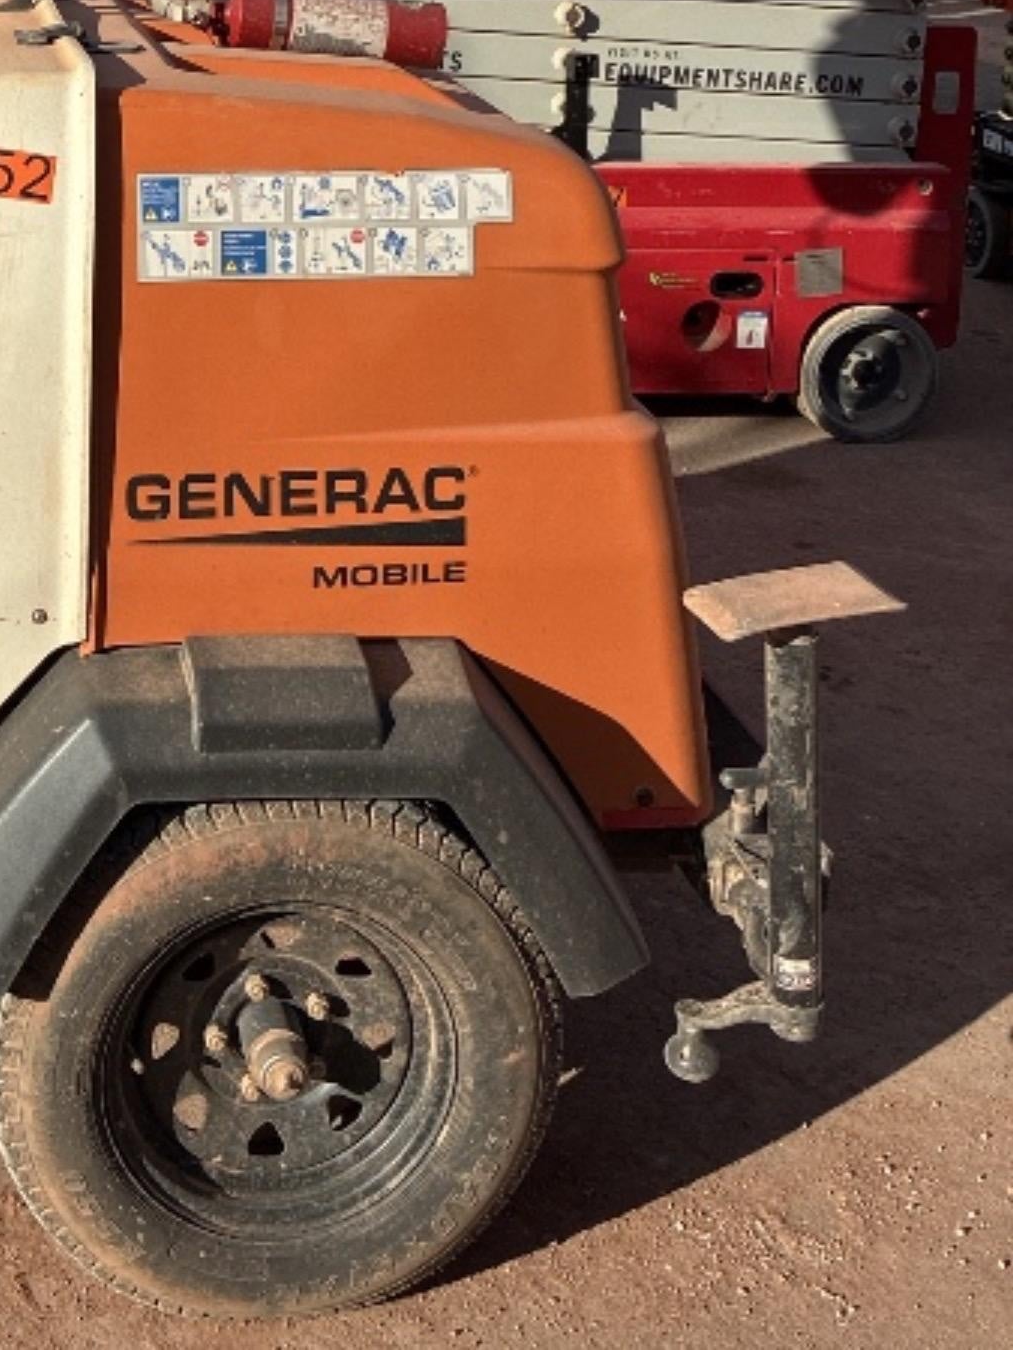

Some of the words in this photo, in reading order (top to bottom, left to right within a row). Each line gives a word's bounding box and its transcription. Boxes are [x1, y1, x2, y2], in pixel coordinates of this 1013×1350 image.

[605, 62, 865, 96] EQUIPMENTSHARE.COM
[126, 466, 466, 521] GENERAC
[313, 562, 466, 588] MOBILE
